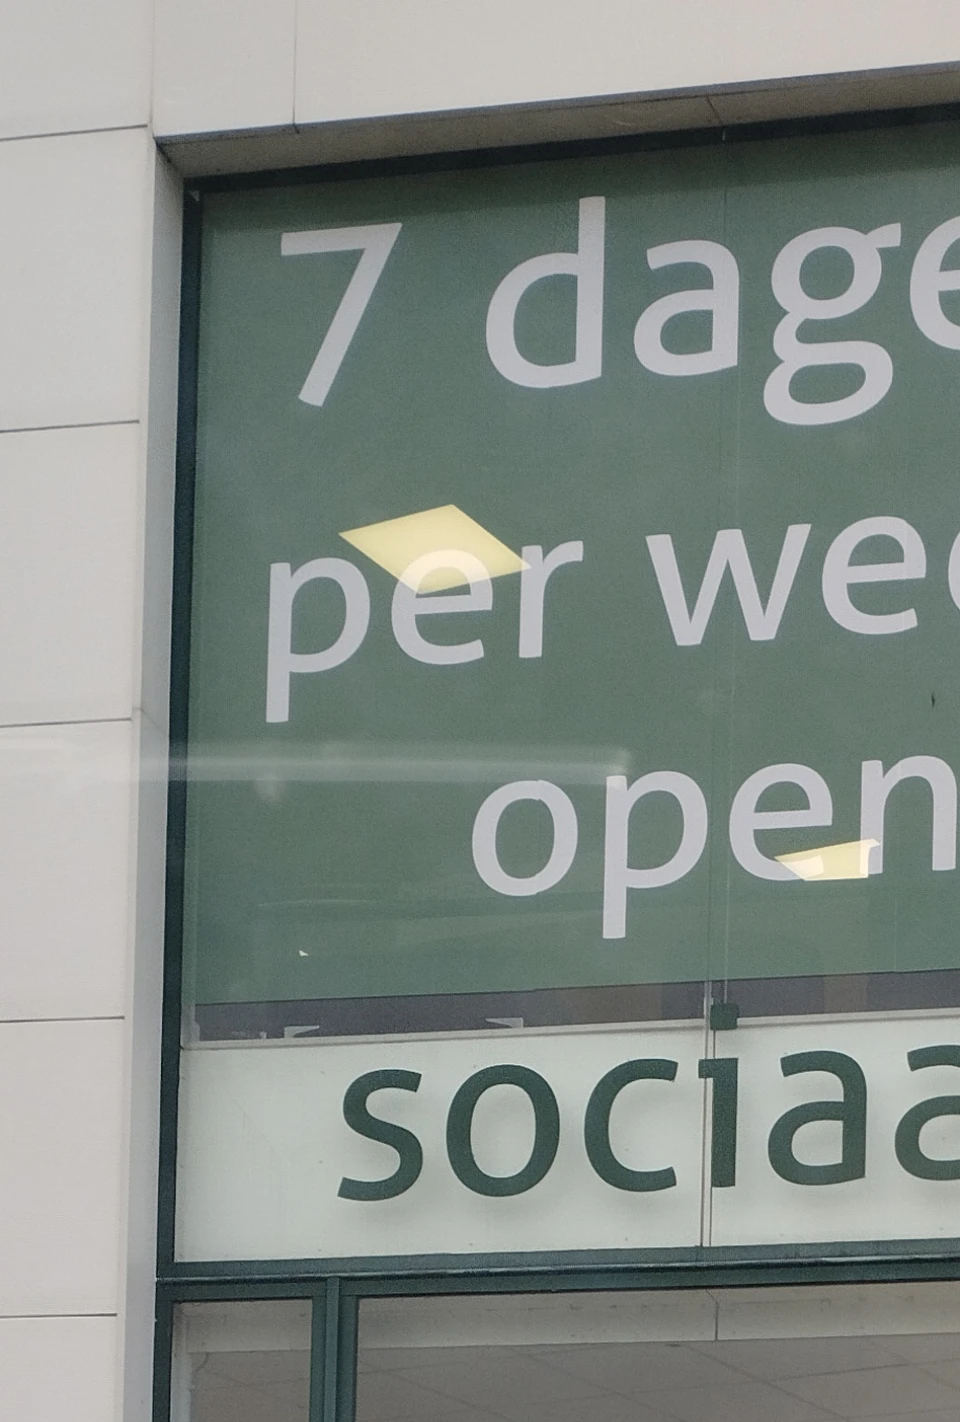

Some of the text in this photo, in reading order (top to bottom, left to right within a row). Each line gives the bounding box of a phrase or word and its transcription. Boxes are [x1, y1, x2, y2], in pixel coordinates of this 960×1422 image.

[280, 222, 403, 408] 7
[266, 538, 584, 723] per
[471, 751, 959, 940] open
